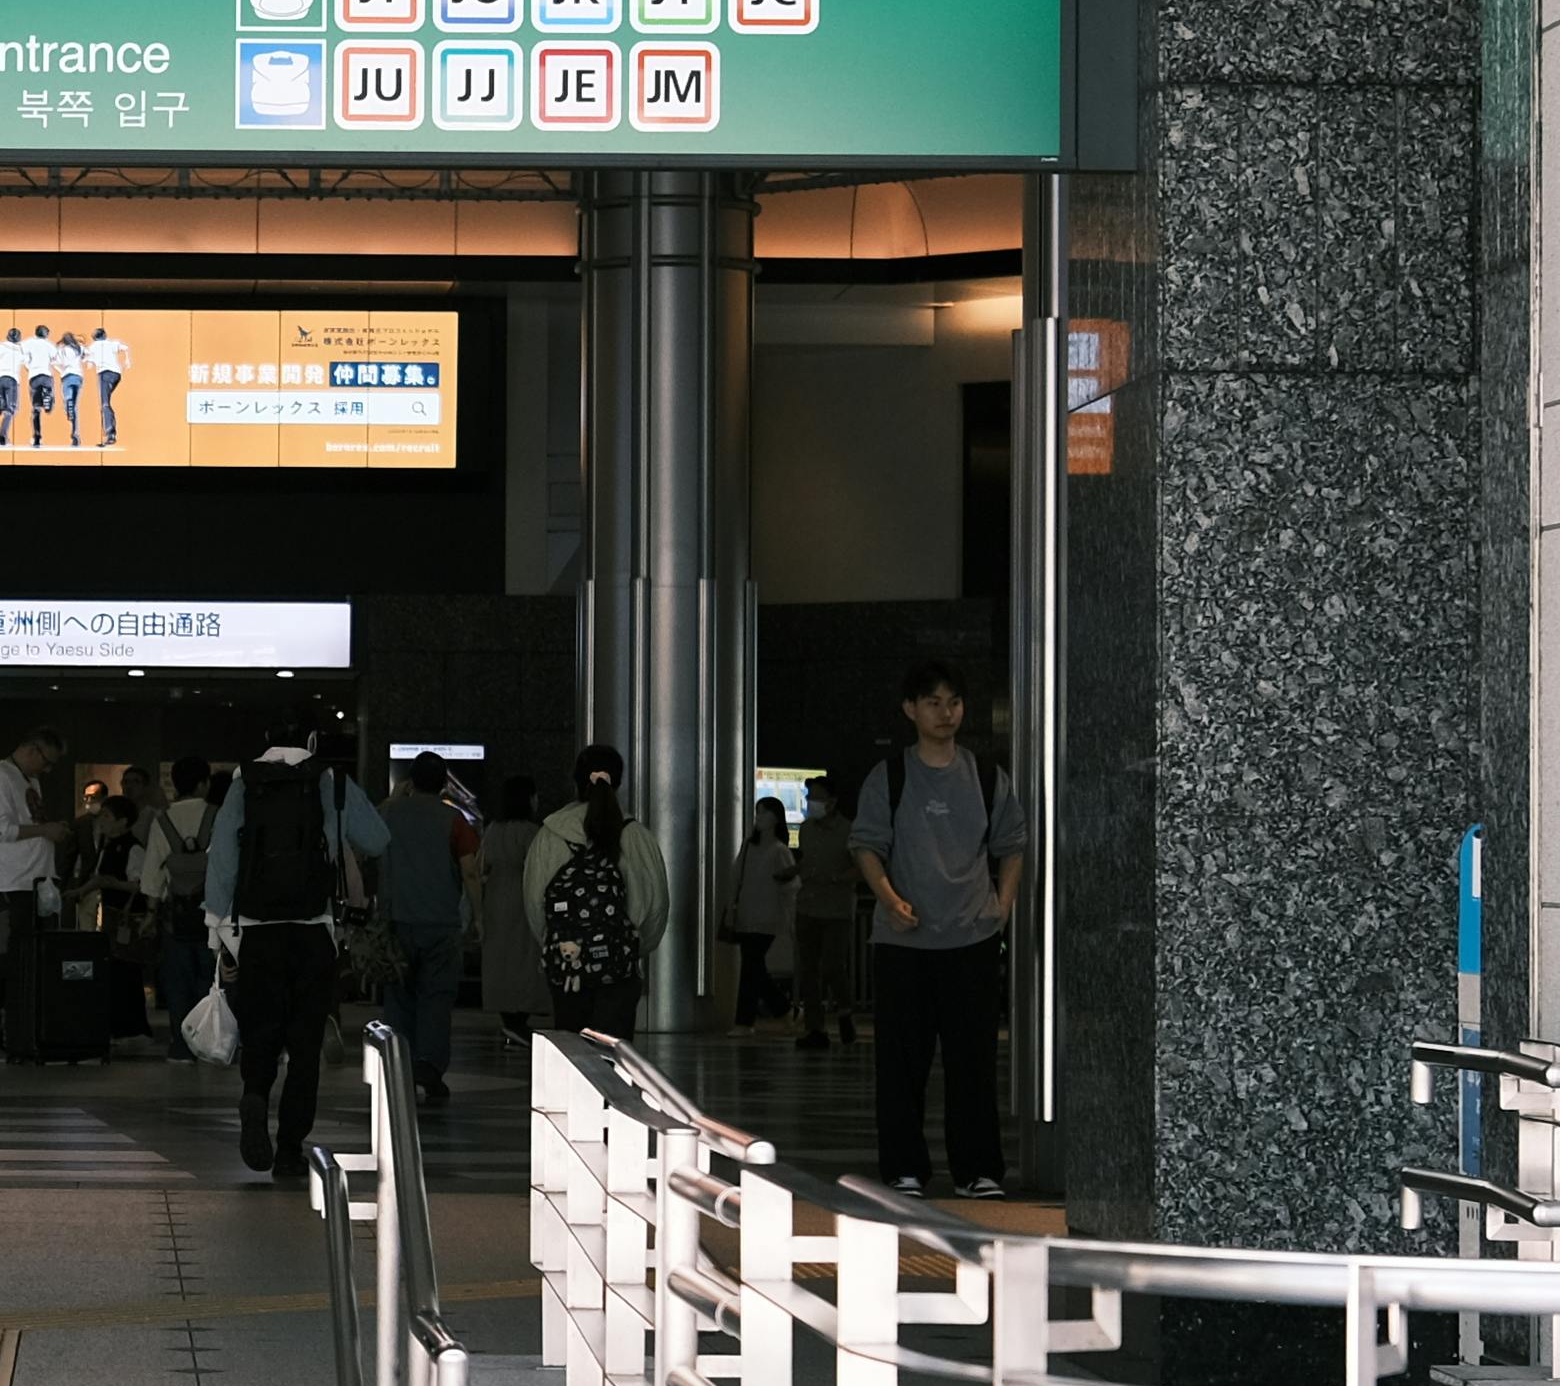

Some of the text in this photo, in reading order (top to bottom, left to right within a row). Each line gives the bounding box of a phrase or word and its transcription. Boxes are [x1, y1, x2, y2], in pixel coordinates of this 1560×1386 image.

[353, 67, 702, 103] JU JJ JE JM
[16, 89, 94, 128] 북쪽
[114, 90, 191, 128] 입구
[188, 363, 324, 385] 新規事業開発
[198, 399, 364, 415] ボーンレックス 採用
[25, 642, 40, 656] to
[45, 642, 94, 657] Yaesu
[99, 642, 135, 657] Side
